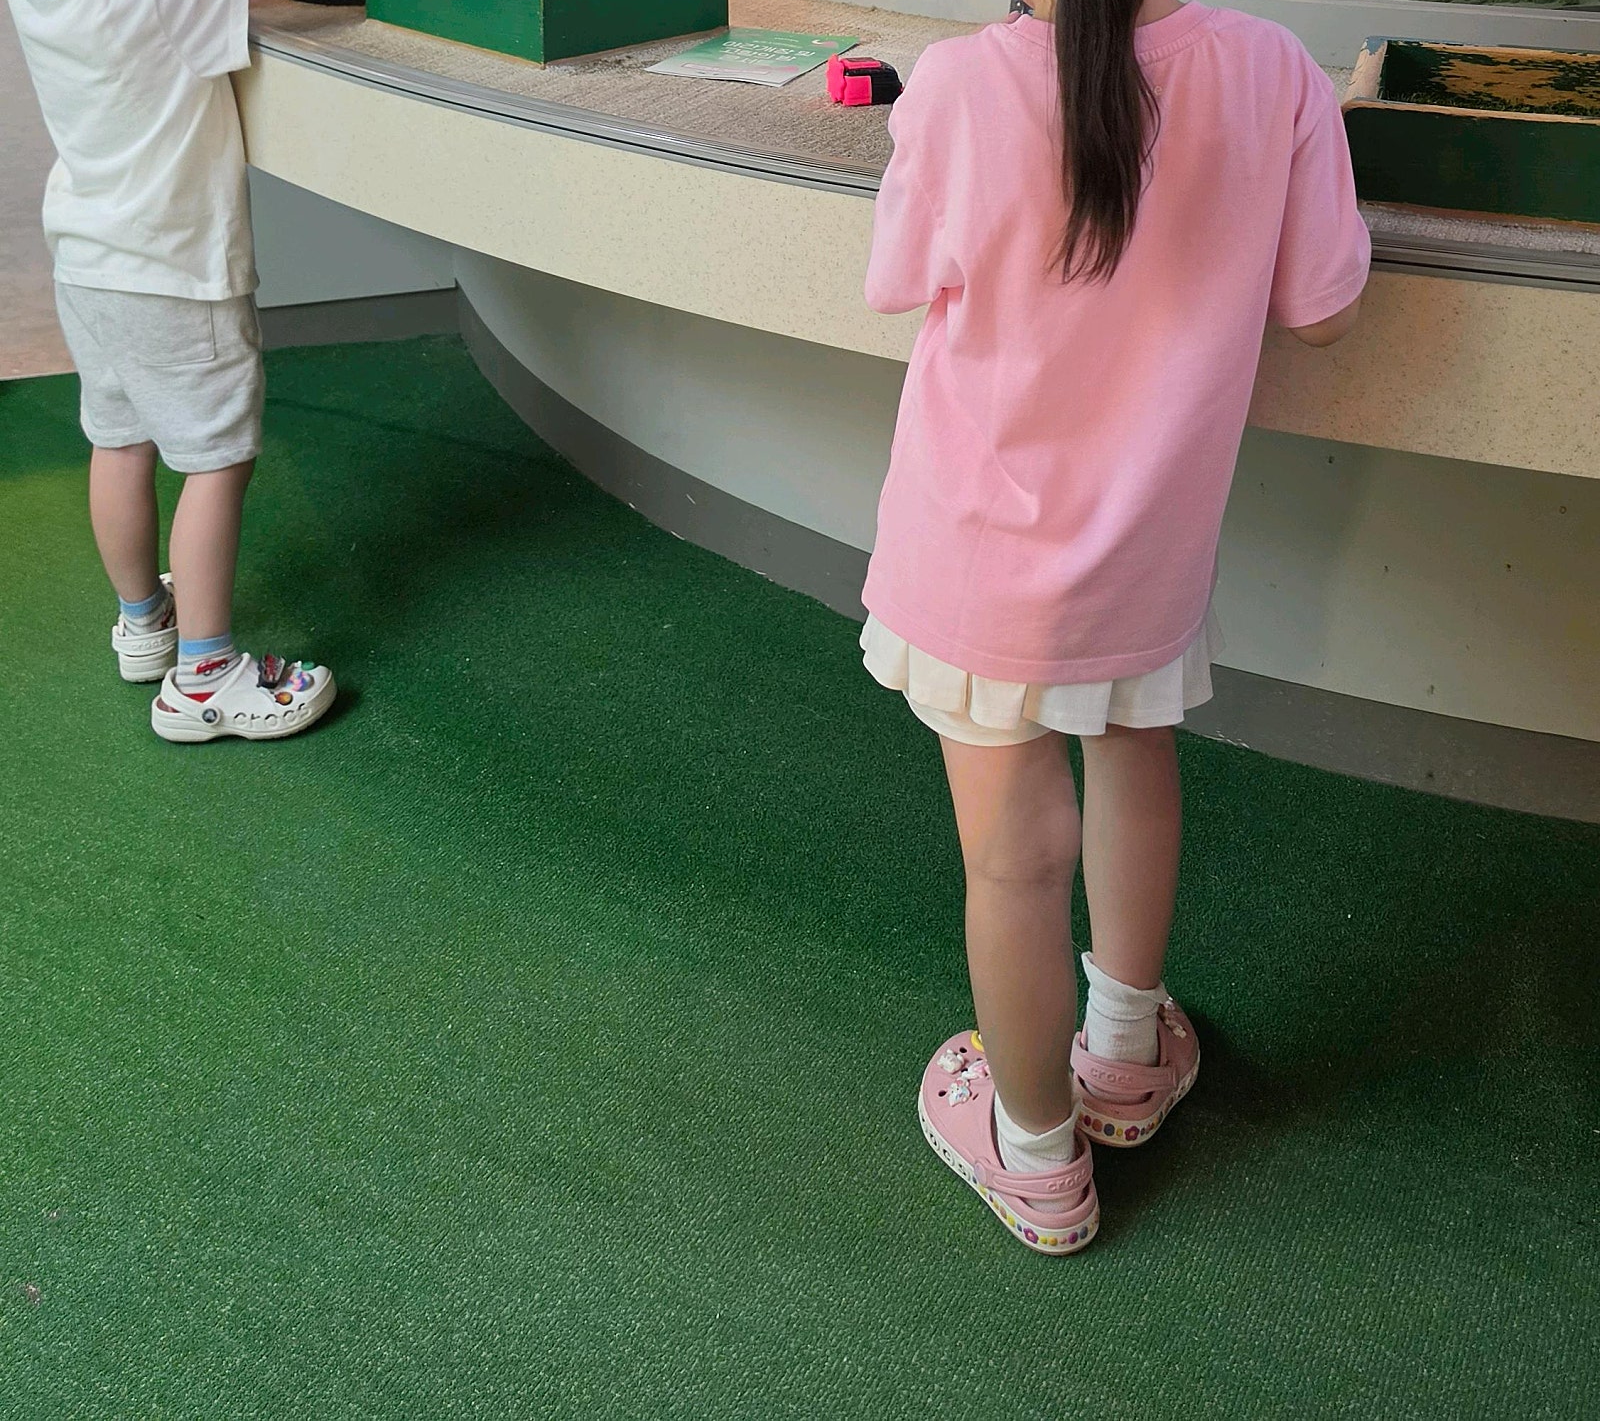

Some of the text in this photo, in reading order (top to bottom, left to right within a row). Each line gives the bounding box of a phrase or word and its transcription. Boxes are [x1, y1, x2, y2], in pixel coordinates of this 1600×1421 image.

[233, 702, 312, 728] crocs
[1090, 1067, 1134, 1084] crocs
[1047, 1168, 1087, 1193] crocs
